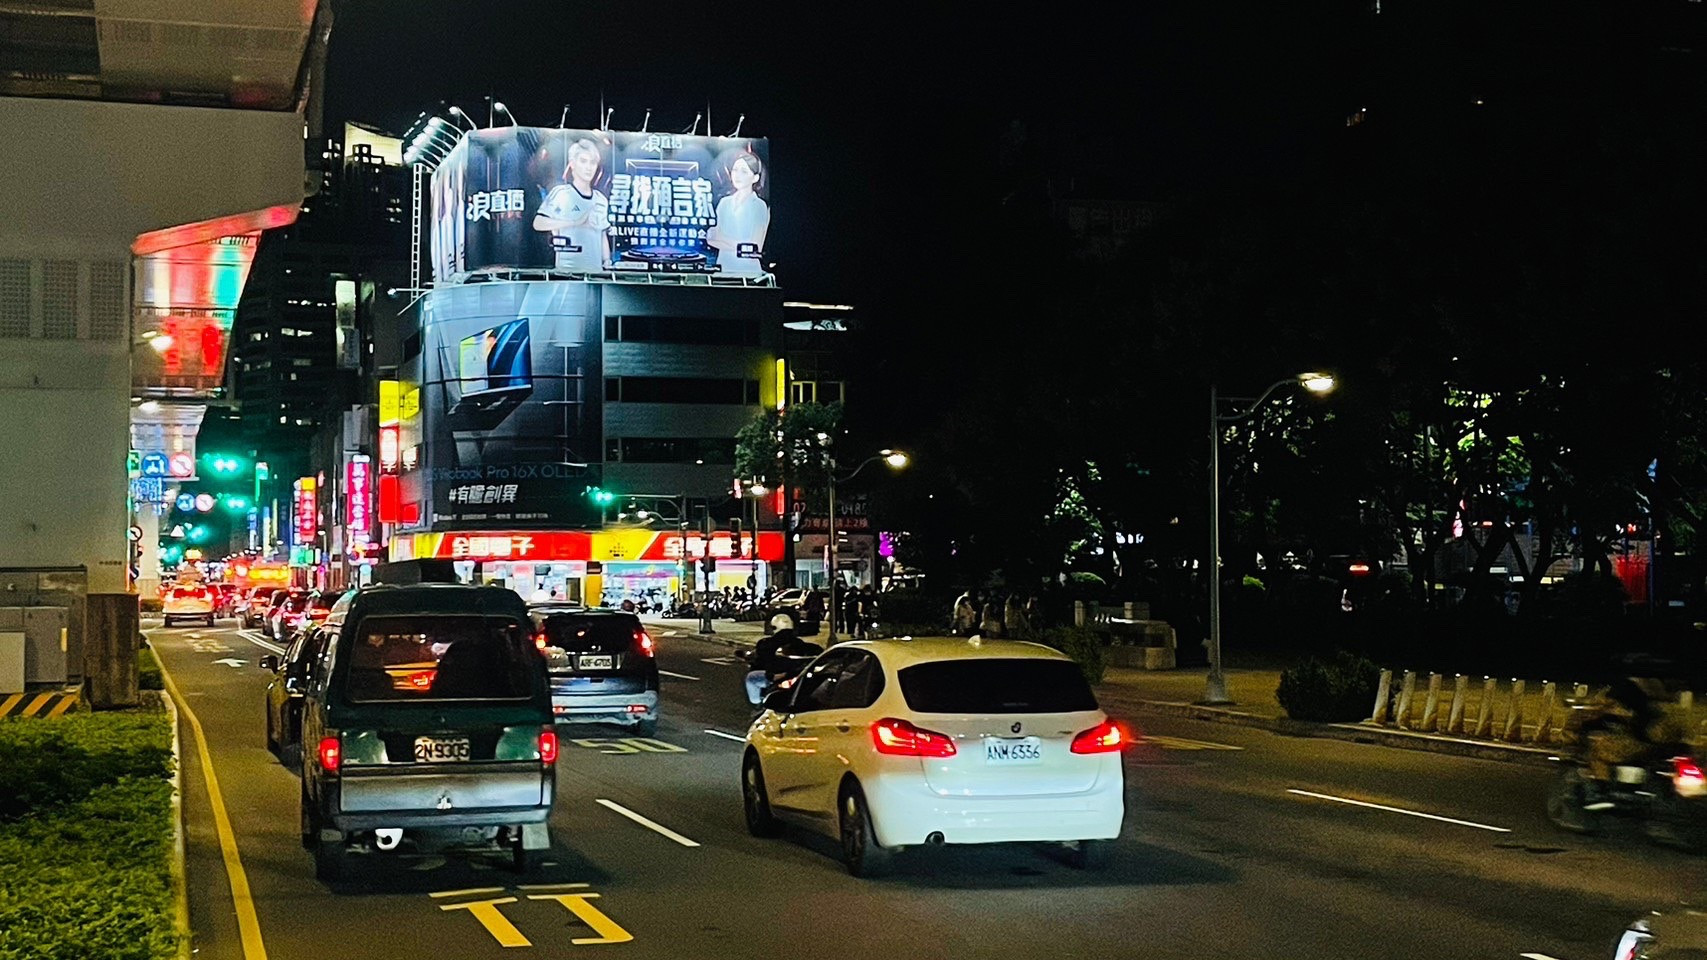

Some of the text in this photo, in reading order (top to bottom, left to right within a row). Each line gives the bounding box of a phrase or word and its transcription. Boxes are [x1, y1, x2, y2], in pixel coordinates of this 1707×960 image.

[466, 189, 524, 222] 浪直播
[608, 174, 716, 218] 尋找預言家
